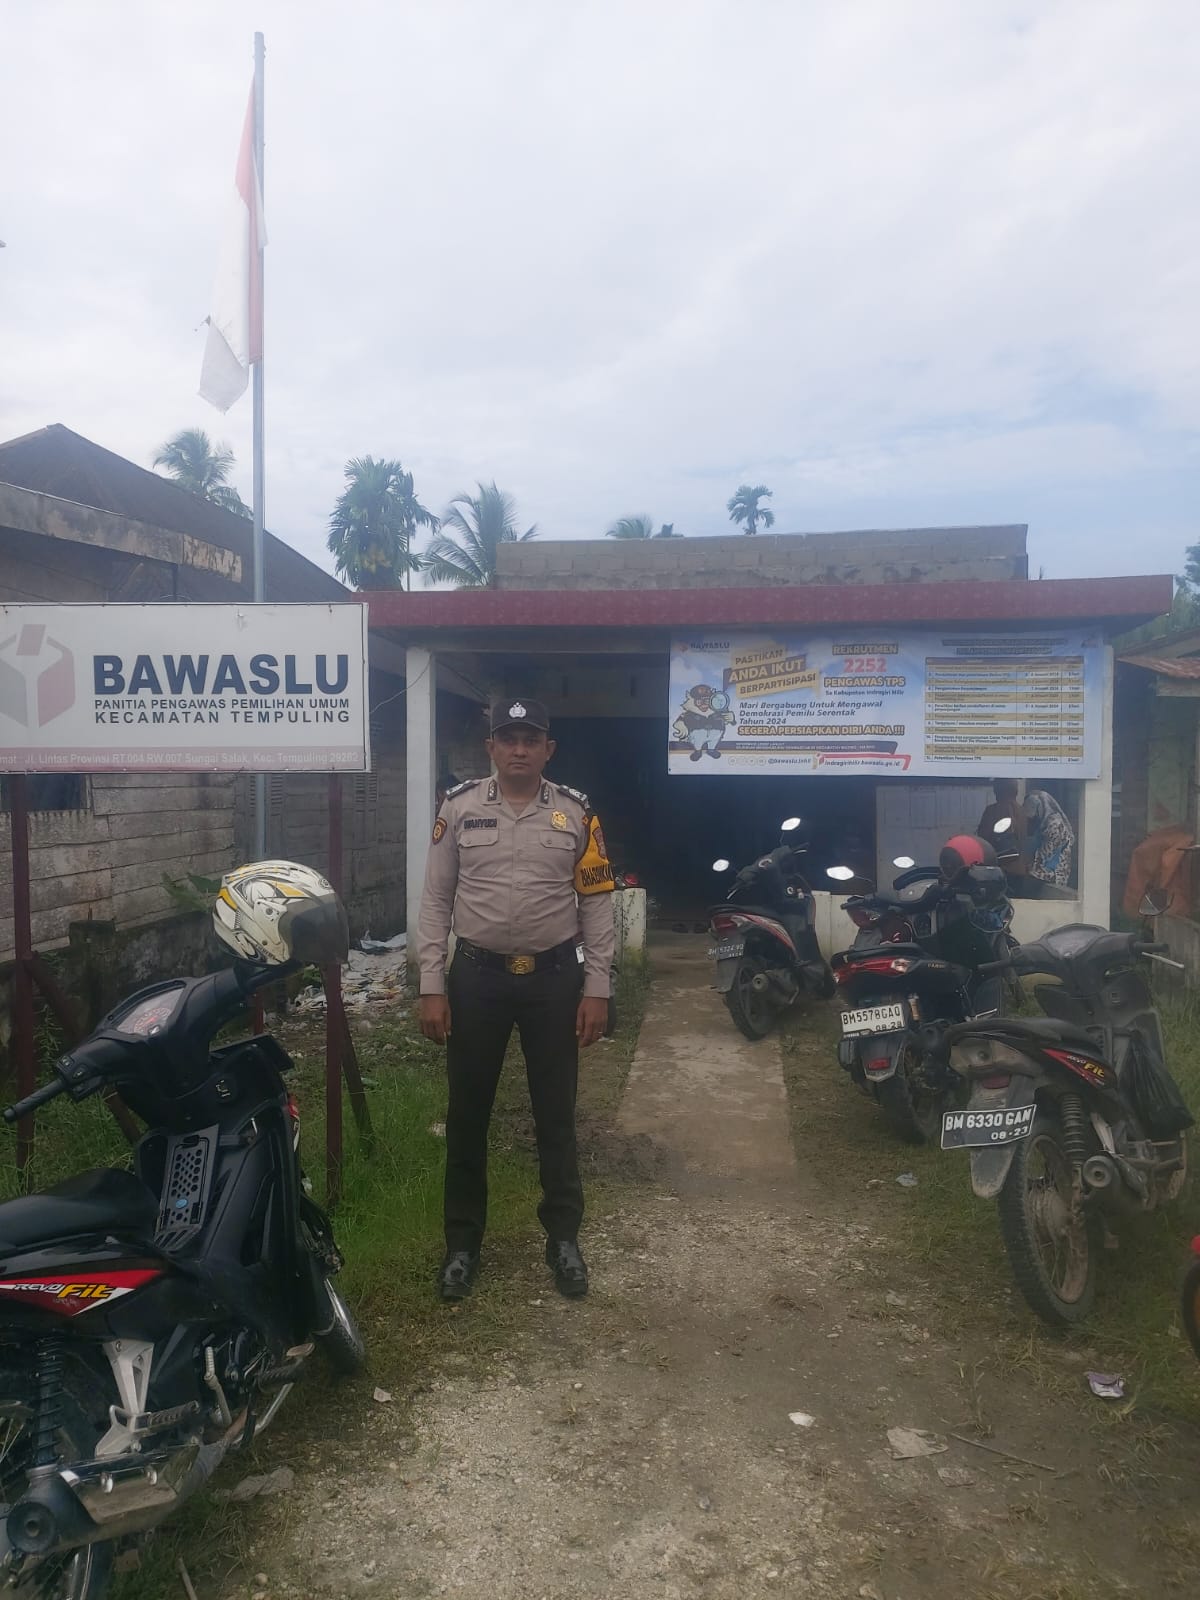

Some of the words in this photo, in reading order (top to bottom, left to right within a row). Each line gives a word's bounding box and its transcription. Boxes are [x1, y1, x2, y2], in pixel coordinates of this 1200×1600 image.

[833, 645, 897, 654] REKRUTMEN
[735, 649, 783, 665] PASTIKAN
[729, 667, 768, 683] ANDA
[771, 658, 804, 675] IKUT
[844, 657, 887, 673] 2252
[93, 654, 349, 695] BAWASLU
[740, 673, 817, 694] BERPARTISIPASI
[825, 677, 882, 687] PENGAWAS
[886, 677, 905, 687] TPS
[95, 700, 146, 710] PANITIA
[151, 700, 226, 710] PENGAWAS
[231, 699, 303, 709] PEMILIHAN
[309, 698, 349, 709] UMUM
[739, 701, 759, 709] Mari
[760, 701, 807, 710] Bergabung
[838, 701, 882, 709] Mengawal
[95, 711, 220, 724] KECAMATAN
[231, 711, 350, 723] TEMPULING
[739, 709, 784, 717] Demokrasi
[739, 726, 777, 735] SEGERA
[778, 726, 840, 735] PERSIAPKAN
[841, 726, 863, 735] DIRI
[864, 726, 894, 735] ANDA
[945, 1113, 965, 1131] BM
[966, 1112, 1003, 1128] 6330
[57, 1284, 112, 1298] Fit
